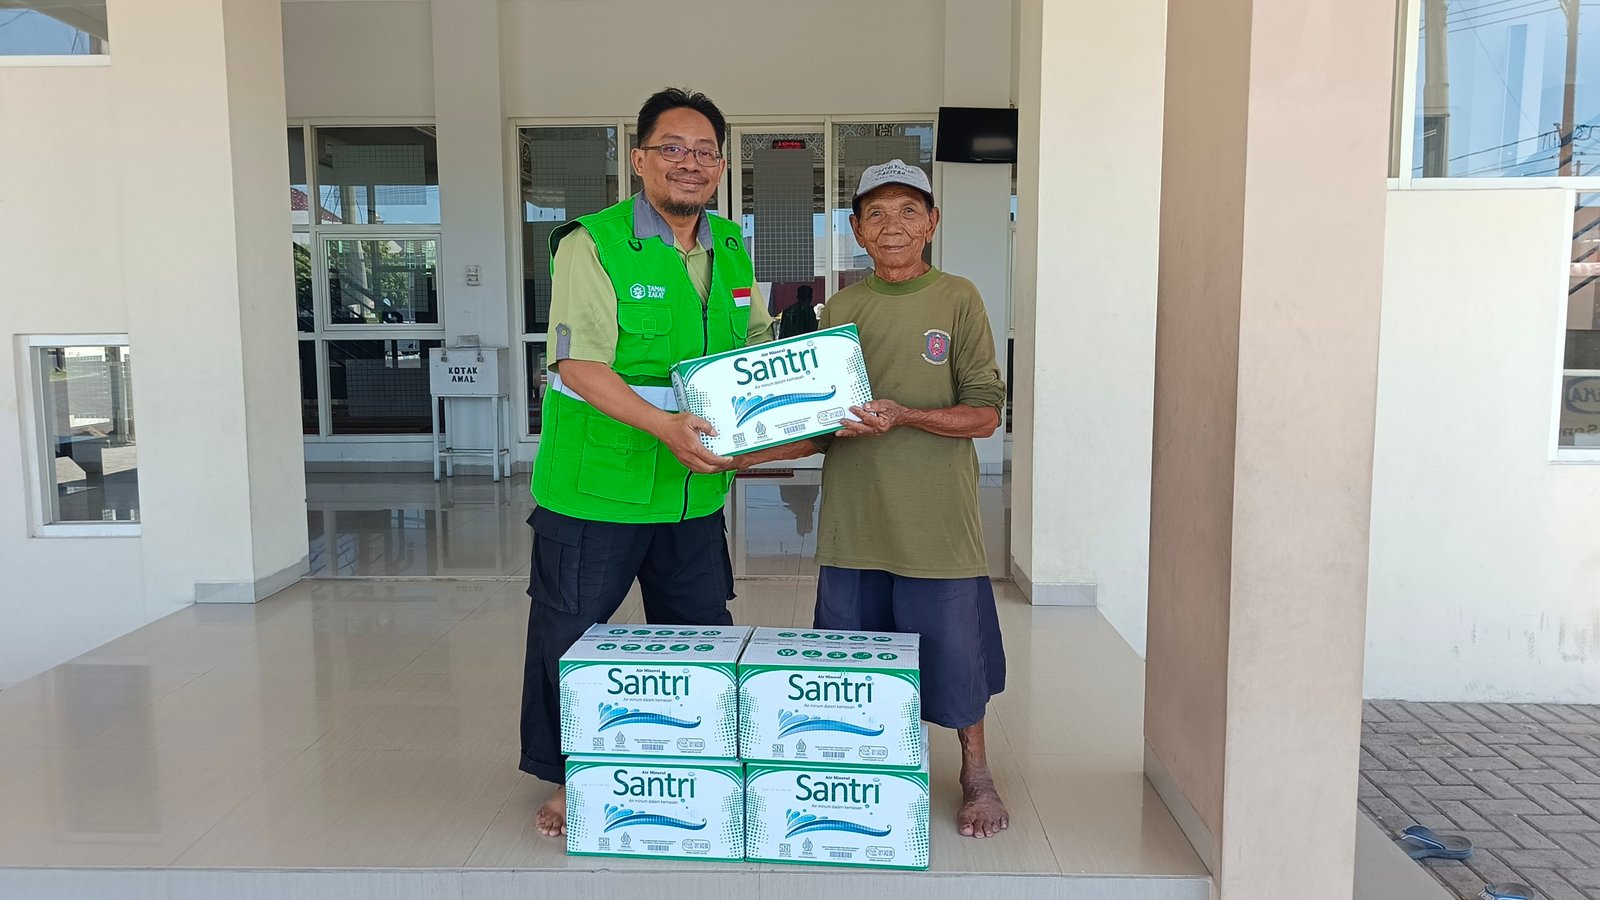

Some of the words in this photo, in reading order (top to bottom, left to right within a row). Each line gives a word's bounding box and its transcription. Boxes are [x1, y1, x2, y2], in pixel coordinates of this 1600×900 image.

[734, 342, 818, 385] Santri
[607, 668, 690, 696] Santri
[788, 674, 872, 703] Santri
[613, 769, 695, 798] Santri
[796, 774, 880, 804] Santri
